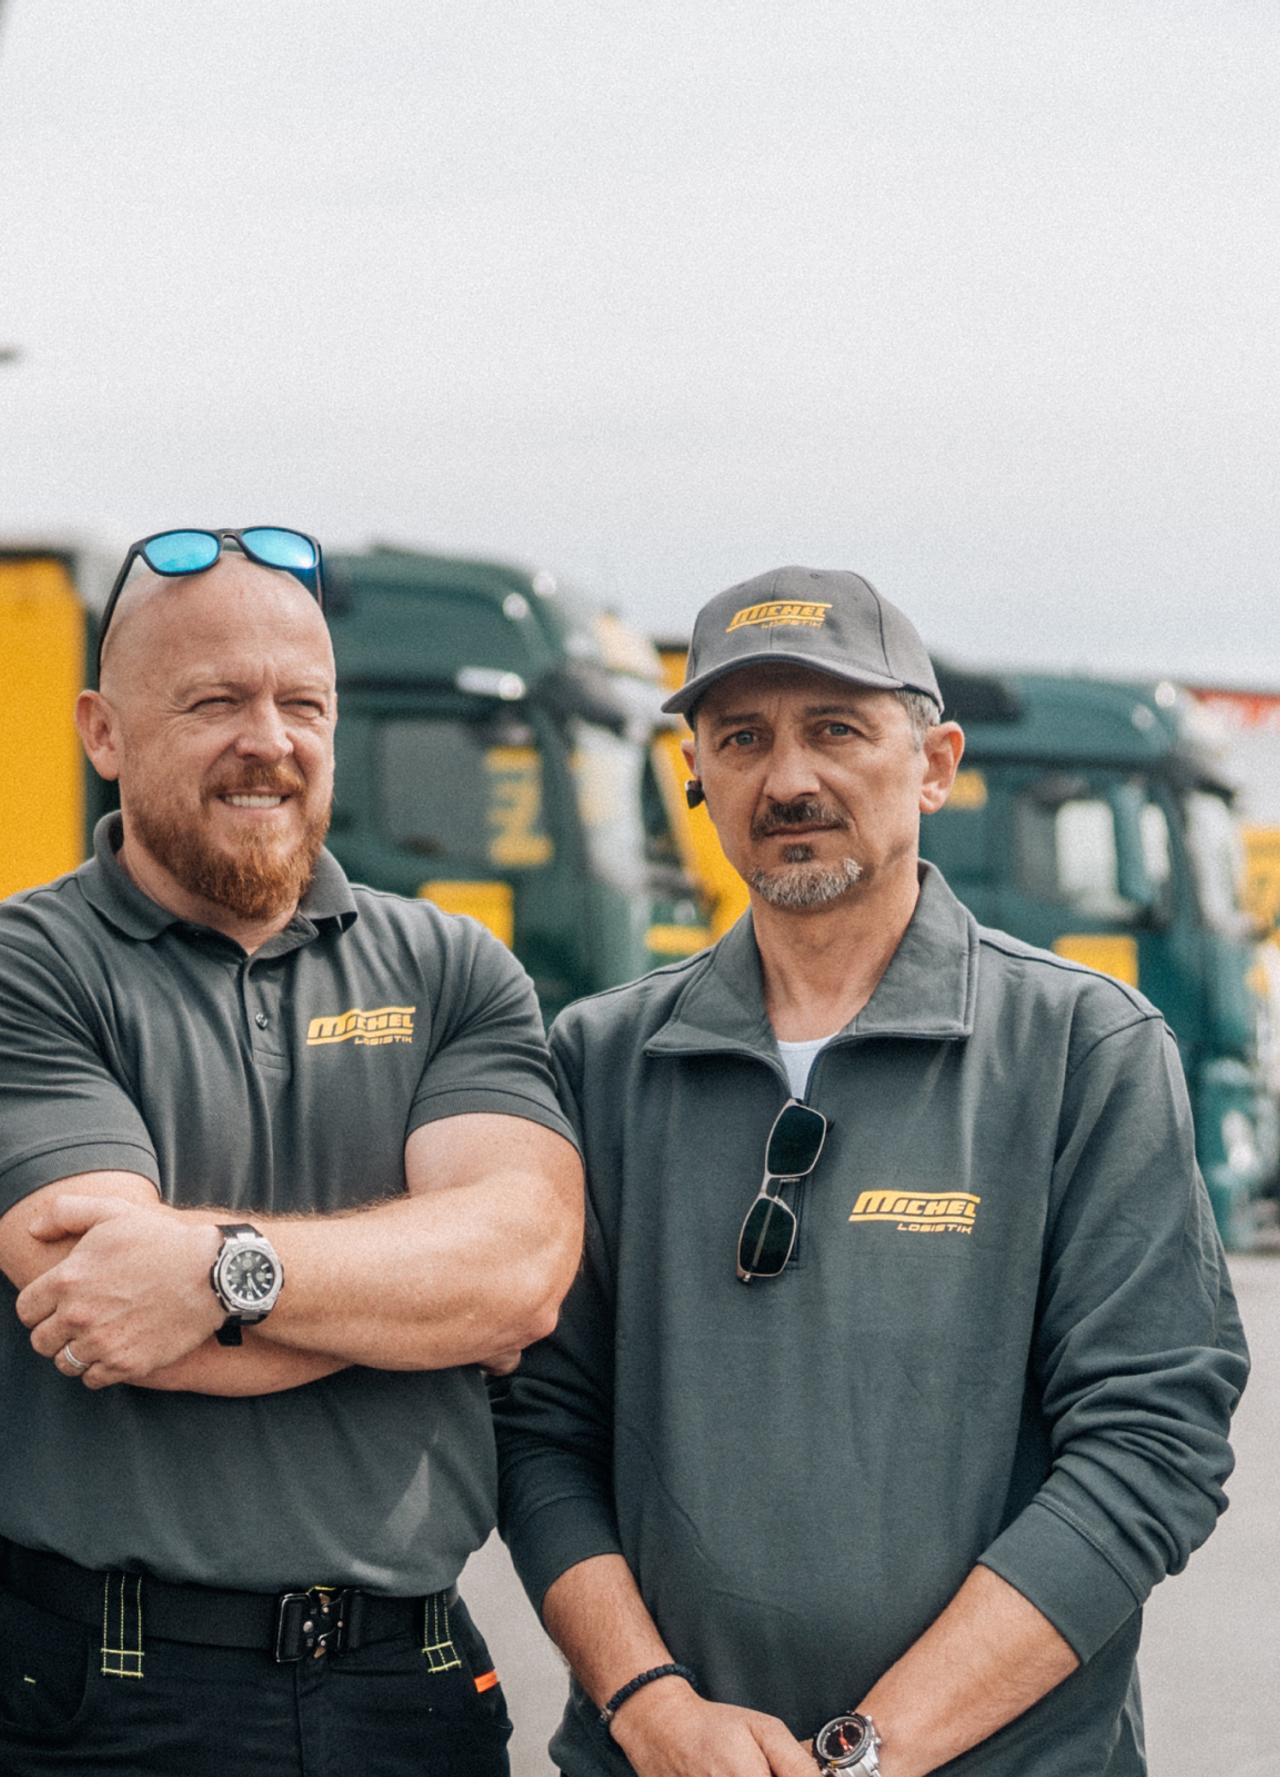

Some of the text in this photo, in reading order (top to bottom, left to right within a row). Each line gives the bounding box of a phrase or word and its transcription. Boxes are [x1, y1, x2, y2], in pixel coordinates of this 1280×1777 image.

[306, 1008, 415, 1040] MICHEL
[850, 1190, 978, 1219] MICHEL
[896, 1222, 973, 1234] LOGISTIK
